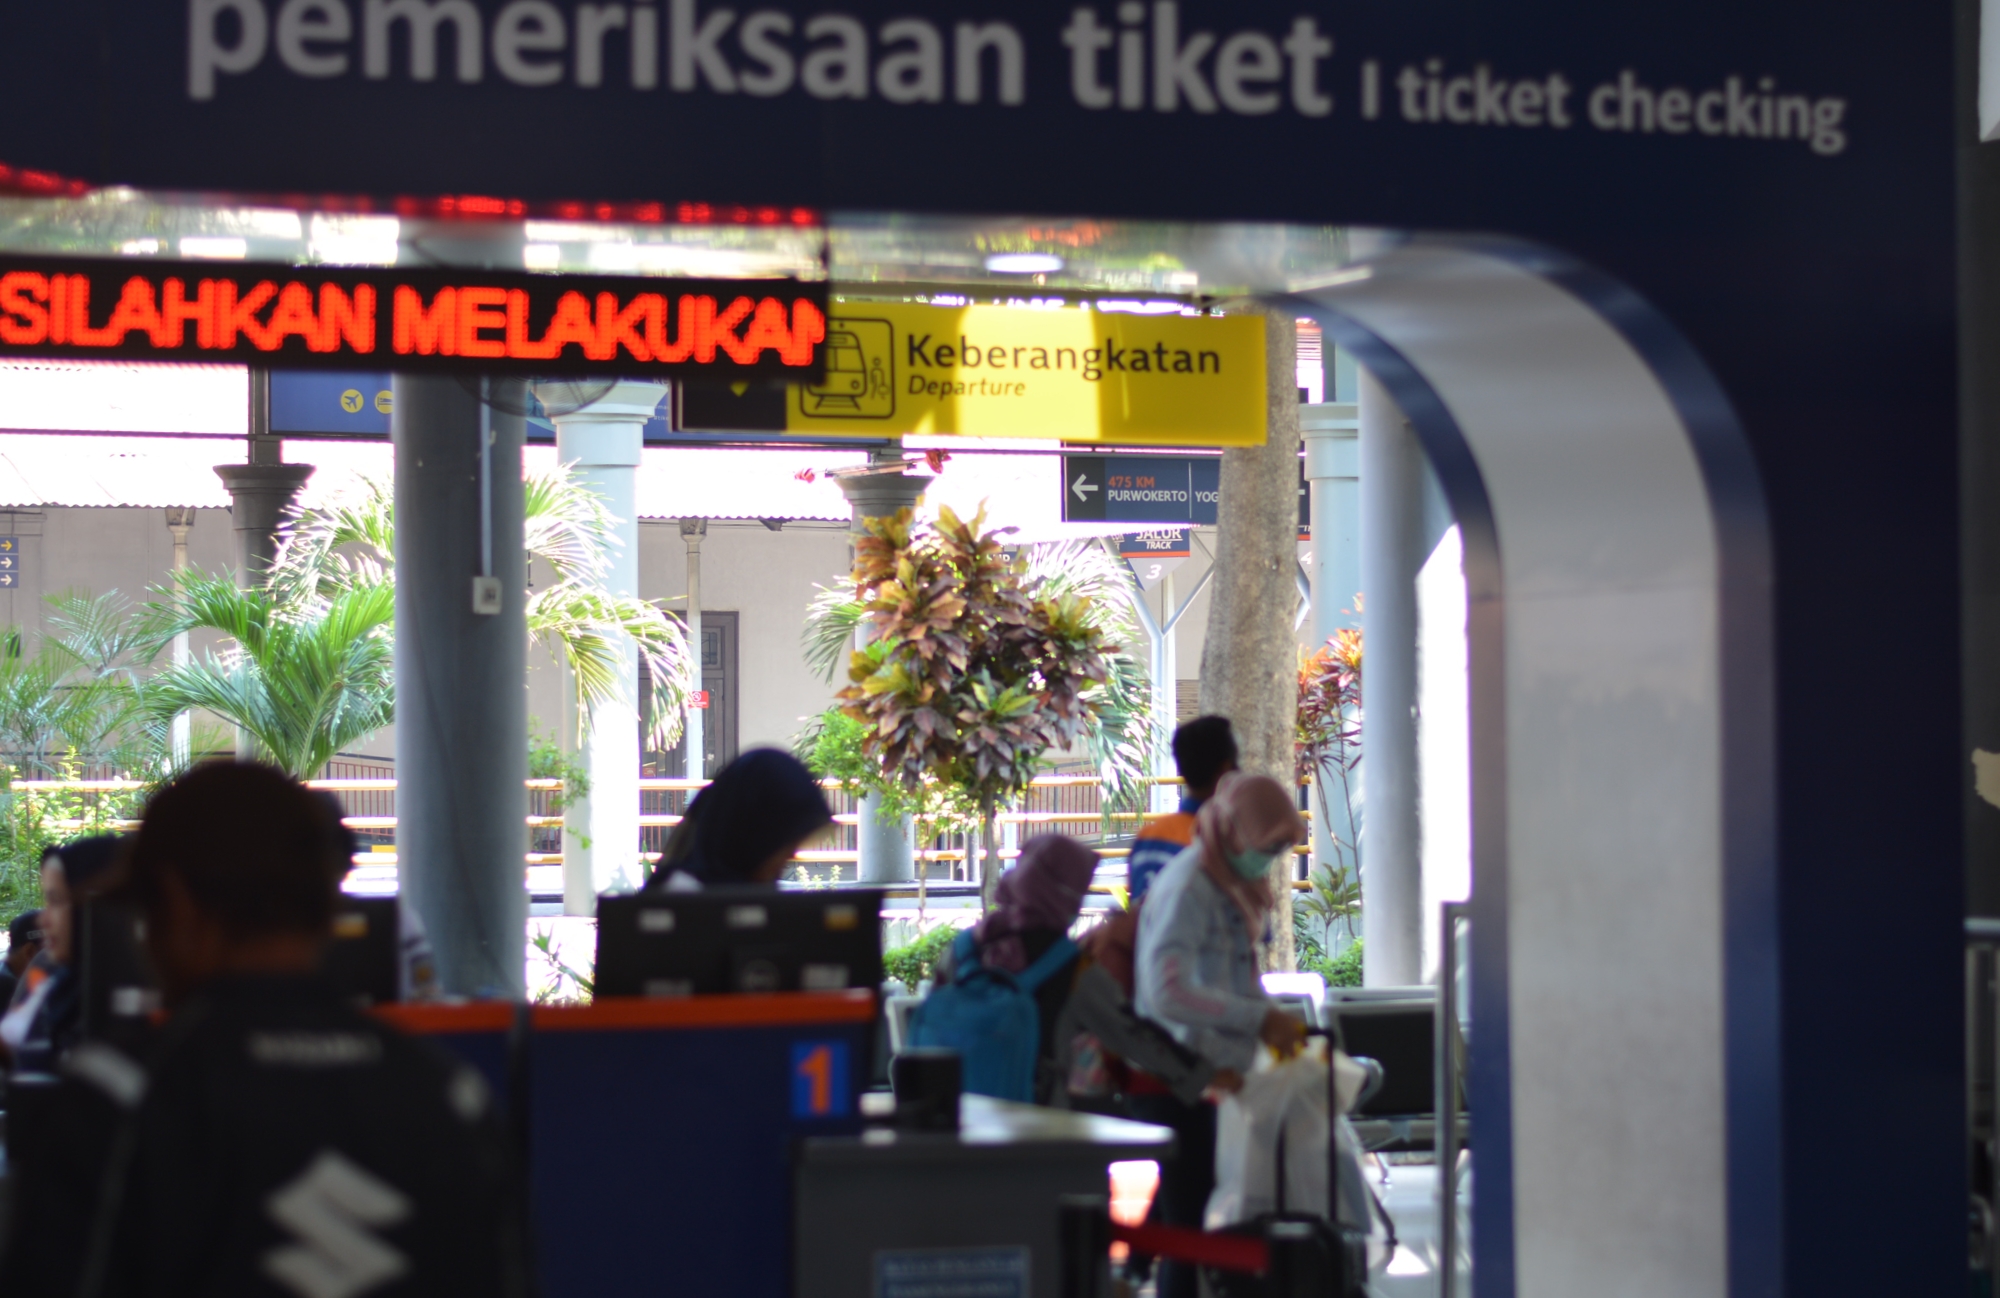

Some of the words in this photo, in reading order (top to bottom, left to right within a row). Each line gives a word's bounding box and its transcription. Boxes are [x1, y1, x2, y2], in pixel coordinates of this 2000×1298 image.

[188, 0, 1025, 105] pemeriksaan
[1062, 0, 1333, 117] tiket
[1398, 59, 1571, 128] ticket
[1589, 70, 1846, 155] checking
[0, 272, 376, 353] SILAHKAN
[907, 333, 1221, 382] Keberangkatan
[907, 374, 1026, 401] Departure
[1108, 476, 1132, 488] 475
[1136, 477, 1155, 488] KM
[1108, 490, 1188, 502] PURWOKERTO
[1146, 541, 1172, 550] TRACK
[1145, 564, 1162, 579] 3
[797, 1046, 830, 1114] 1
